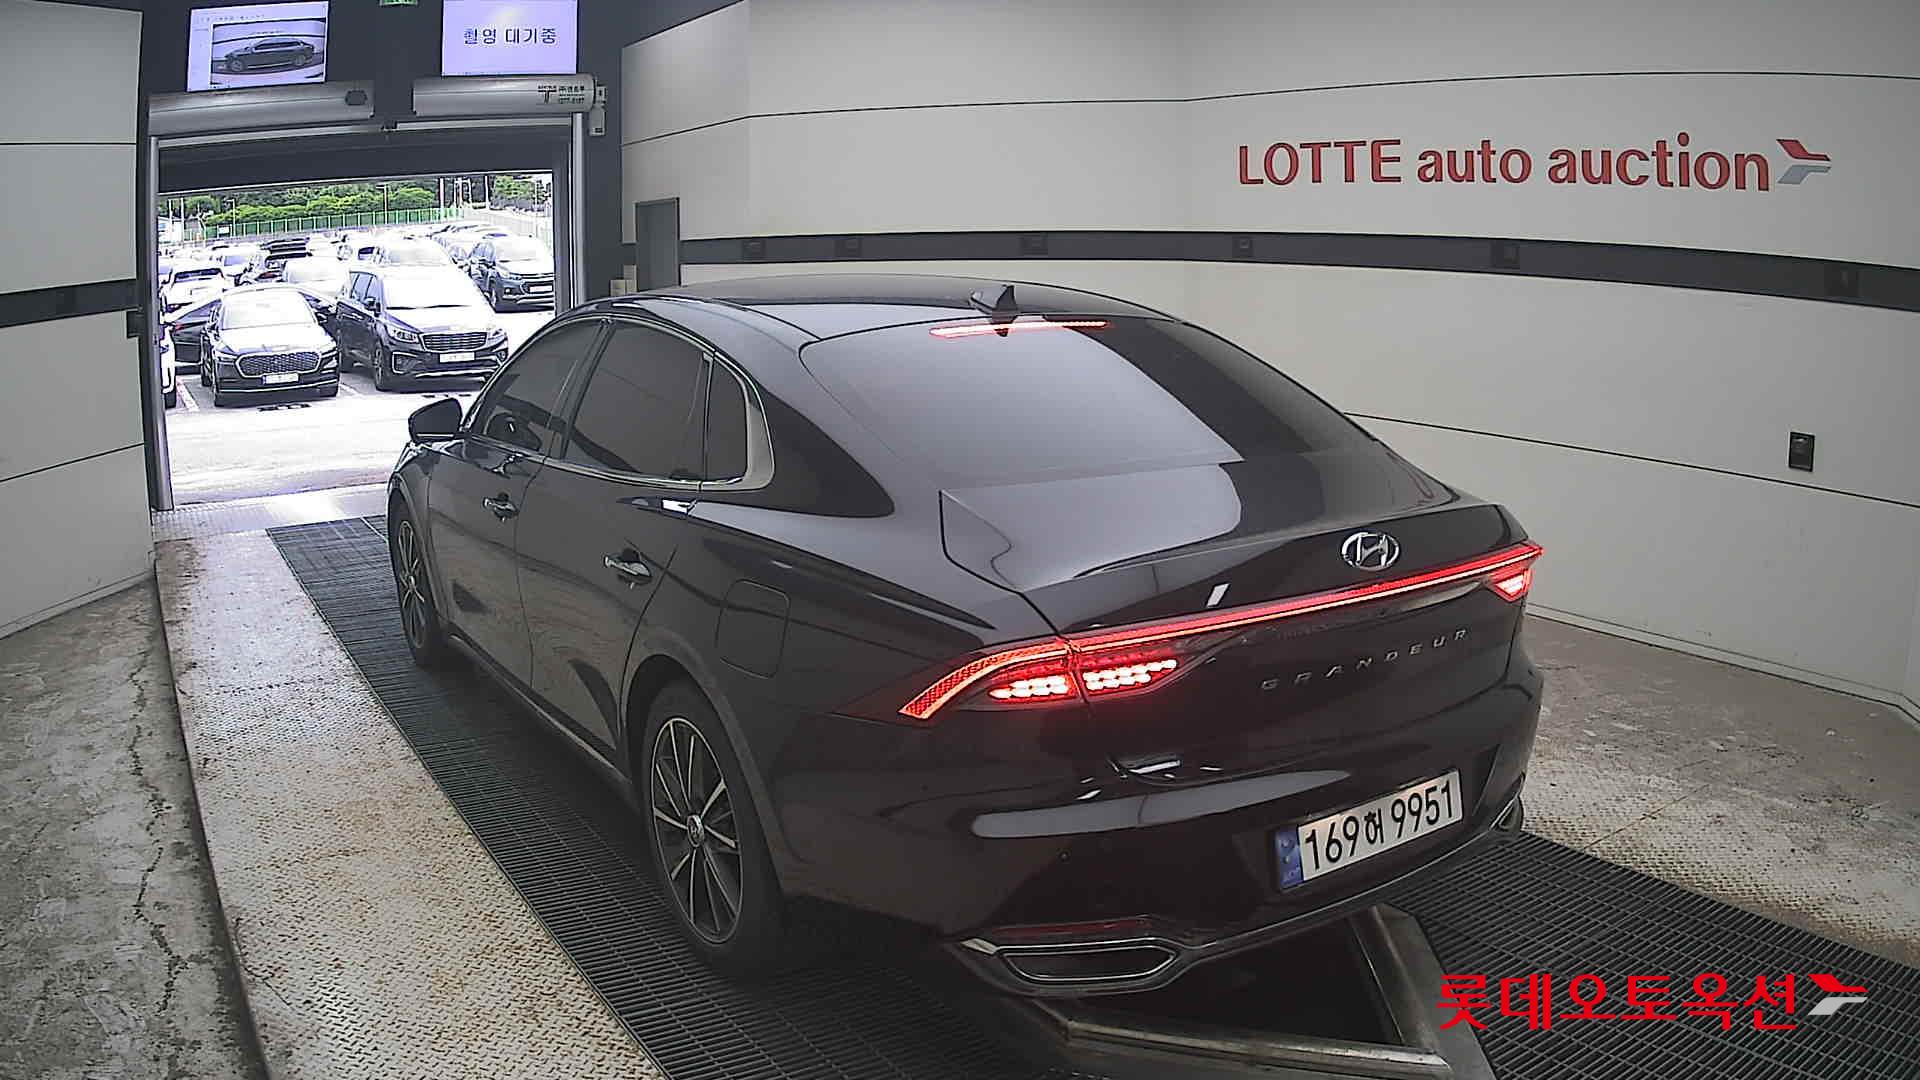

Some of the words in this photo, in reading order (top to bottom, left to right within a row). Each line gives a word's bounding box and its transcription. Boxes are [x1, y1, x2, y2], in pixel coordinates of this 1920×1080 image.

[505, 27, 557, 44] 대기중
[1238, 139, 1401, 185] LOTTE
[1416, 138, 1532, 185] auto
[1548, 132, 1770, 192] auction
[1261, 629, 1467, 690] GRANDEUR
[1305, 808, 1384, 870] 169허
[1391, 780, 1453, 839] 9951
